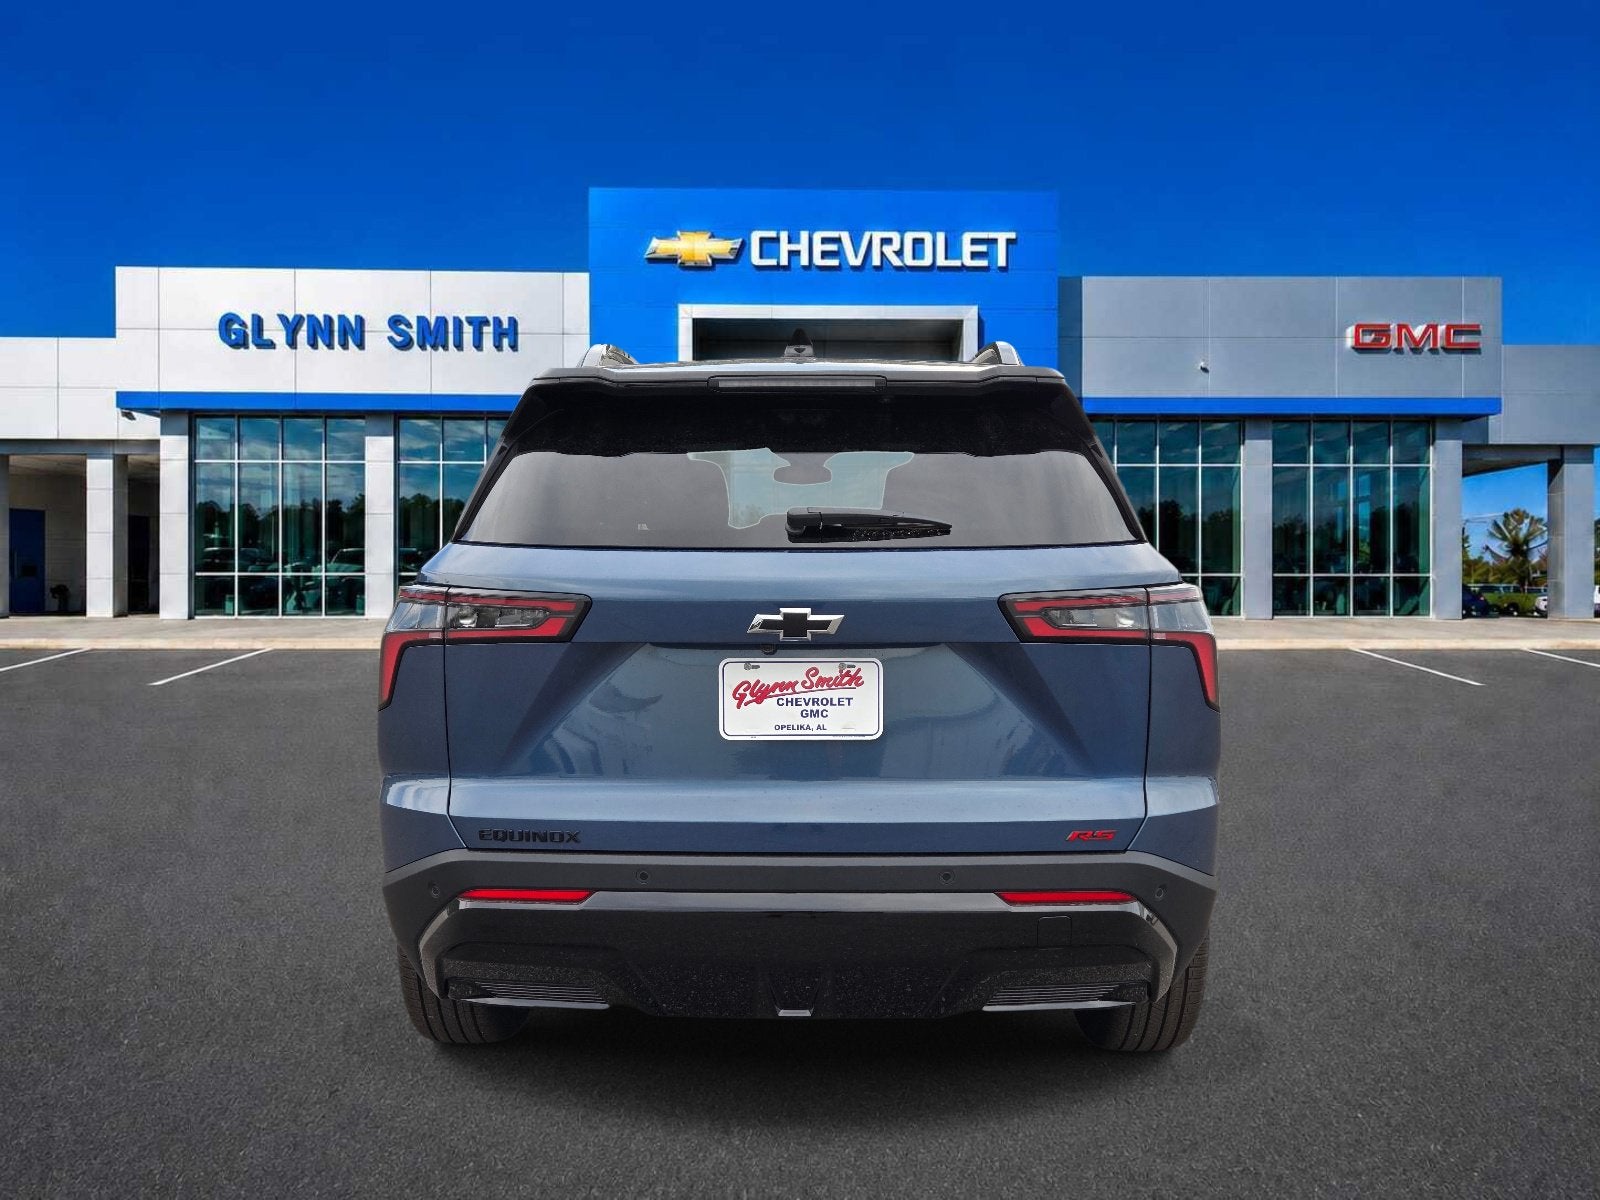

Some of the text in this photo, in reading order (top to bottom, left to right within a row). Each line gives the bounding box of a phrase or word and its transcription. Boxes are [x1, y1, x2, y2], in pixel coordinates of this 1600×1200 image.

[750, 230, 1017, 269] CHEVROLET
[218, 312, 519, 352] GLYNN SMITH
[1348, 322, 1482, 353] GMC
[731, 666, 865, 709] Glynn Smith
[776, 697, 854, 707] CHEVROLET
[800, 709, 829, 719] GMC
[774, 724, 814, 732] OPELIKA,
[478, 828, 582, 843] EQUINOX
[1066, 829, 1119, 842] RS
